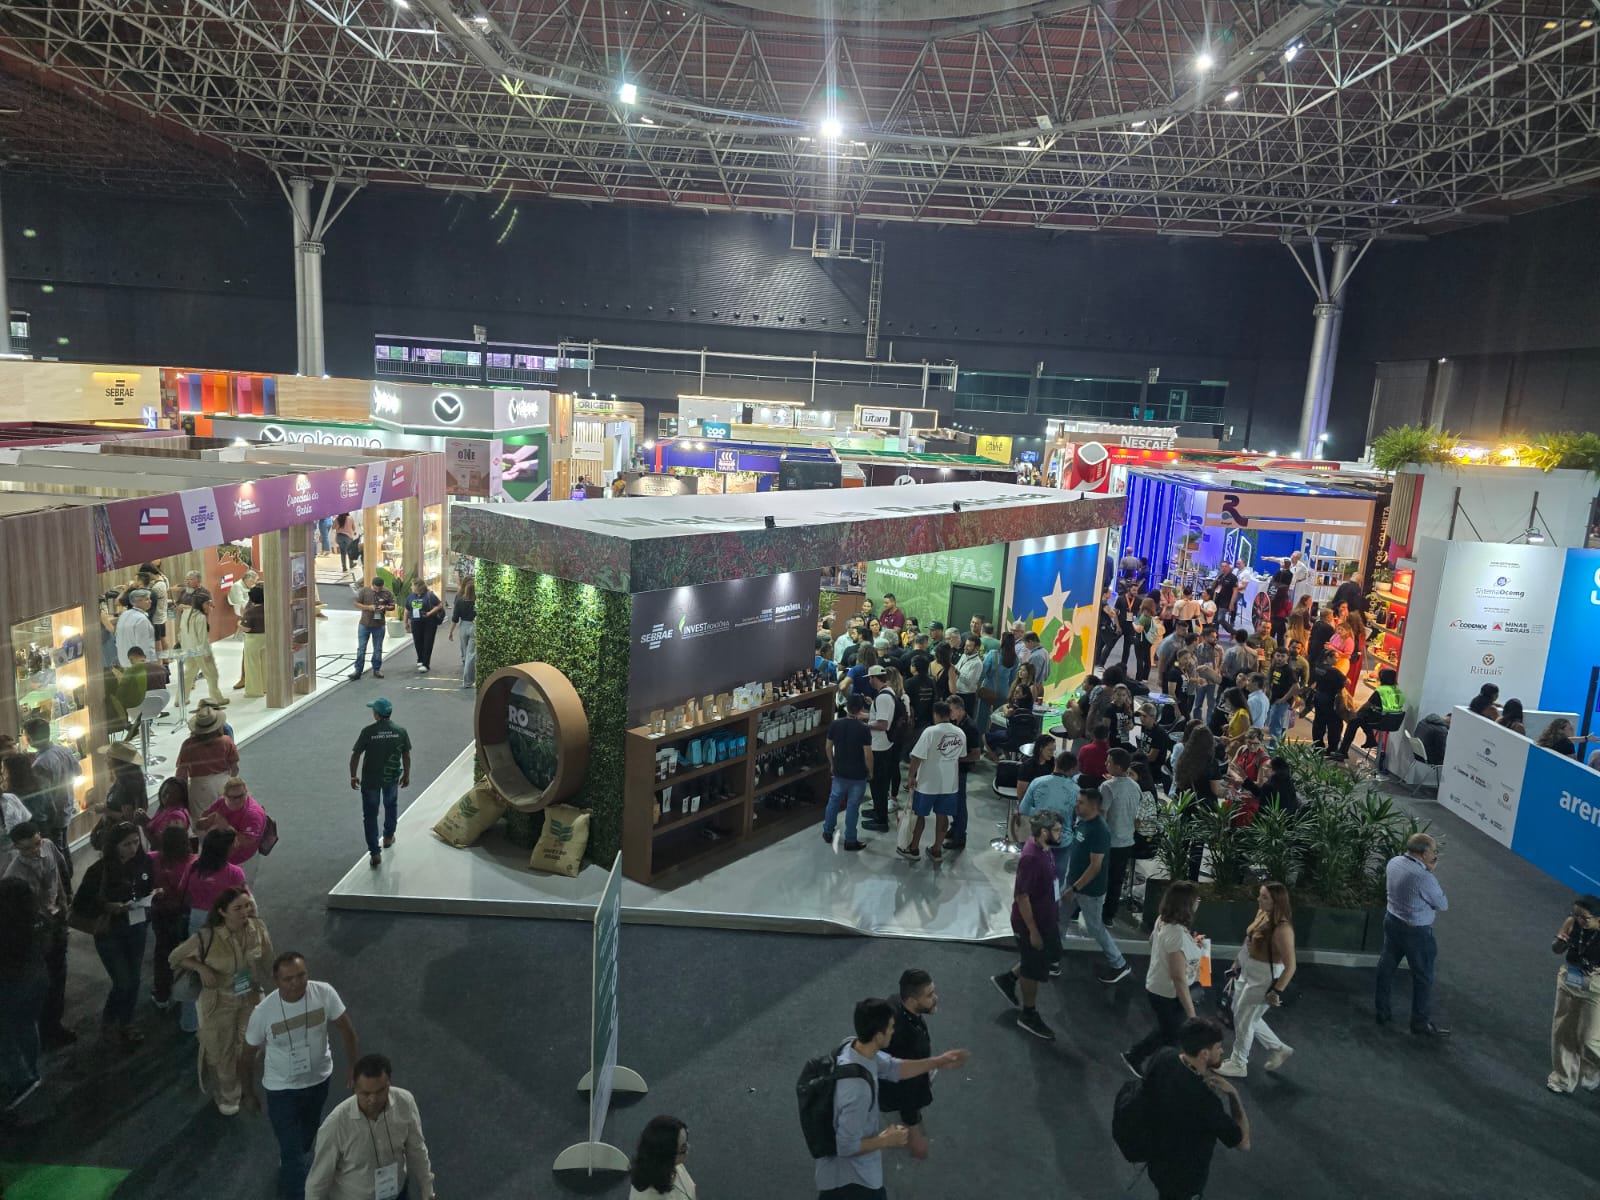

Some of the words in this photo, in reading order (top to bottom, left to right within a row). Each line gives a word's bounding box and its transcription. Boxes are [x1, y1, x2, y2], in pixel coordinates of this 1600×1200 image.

[105, 388, 134, 397] SEBRAE
[190, 511, 215, 525] SEBRAE
[640, 628, 674, 644] SEBRAE
